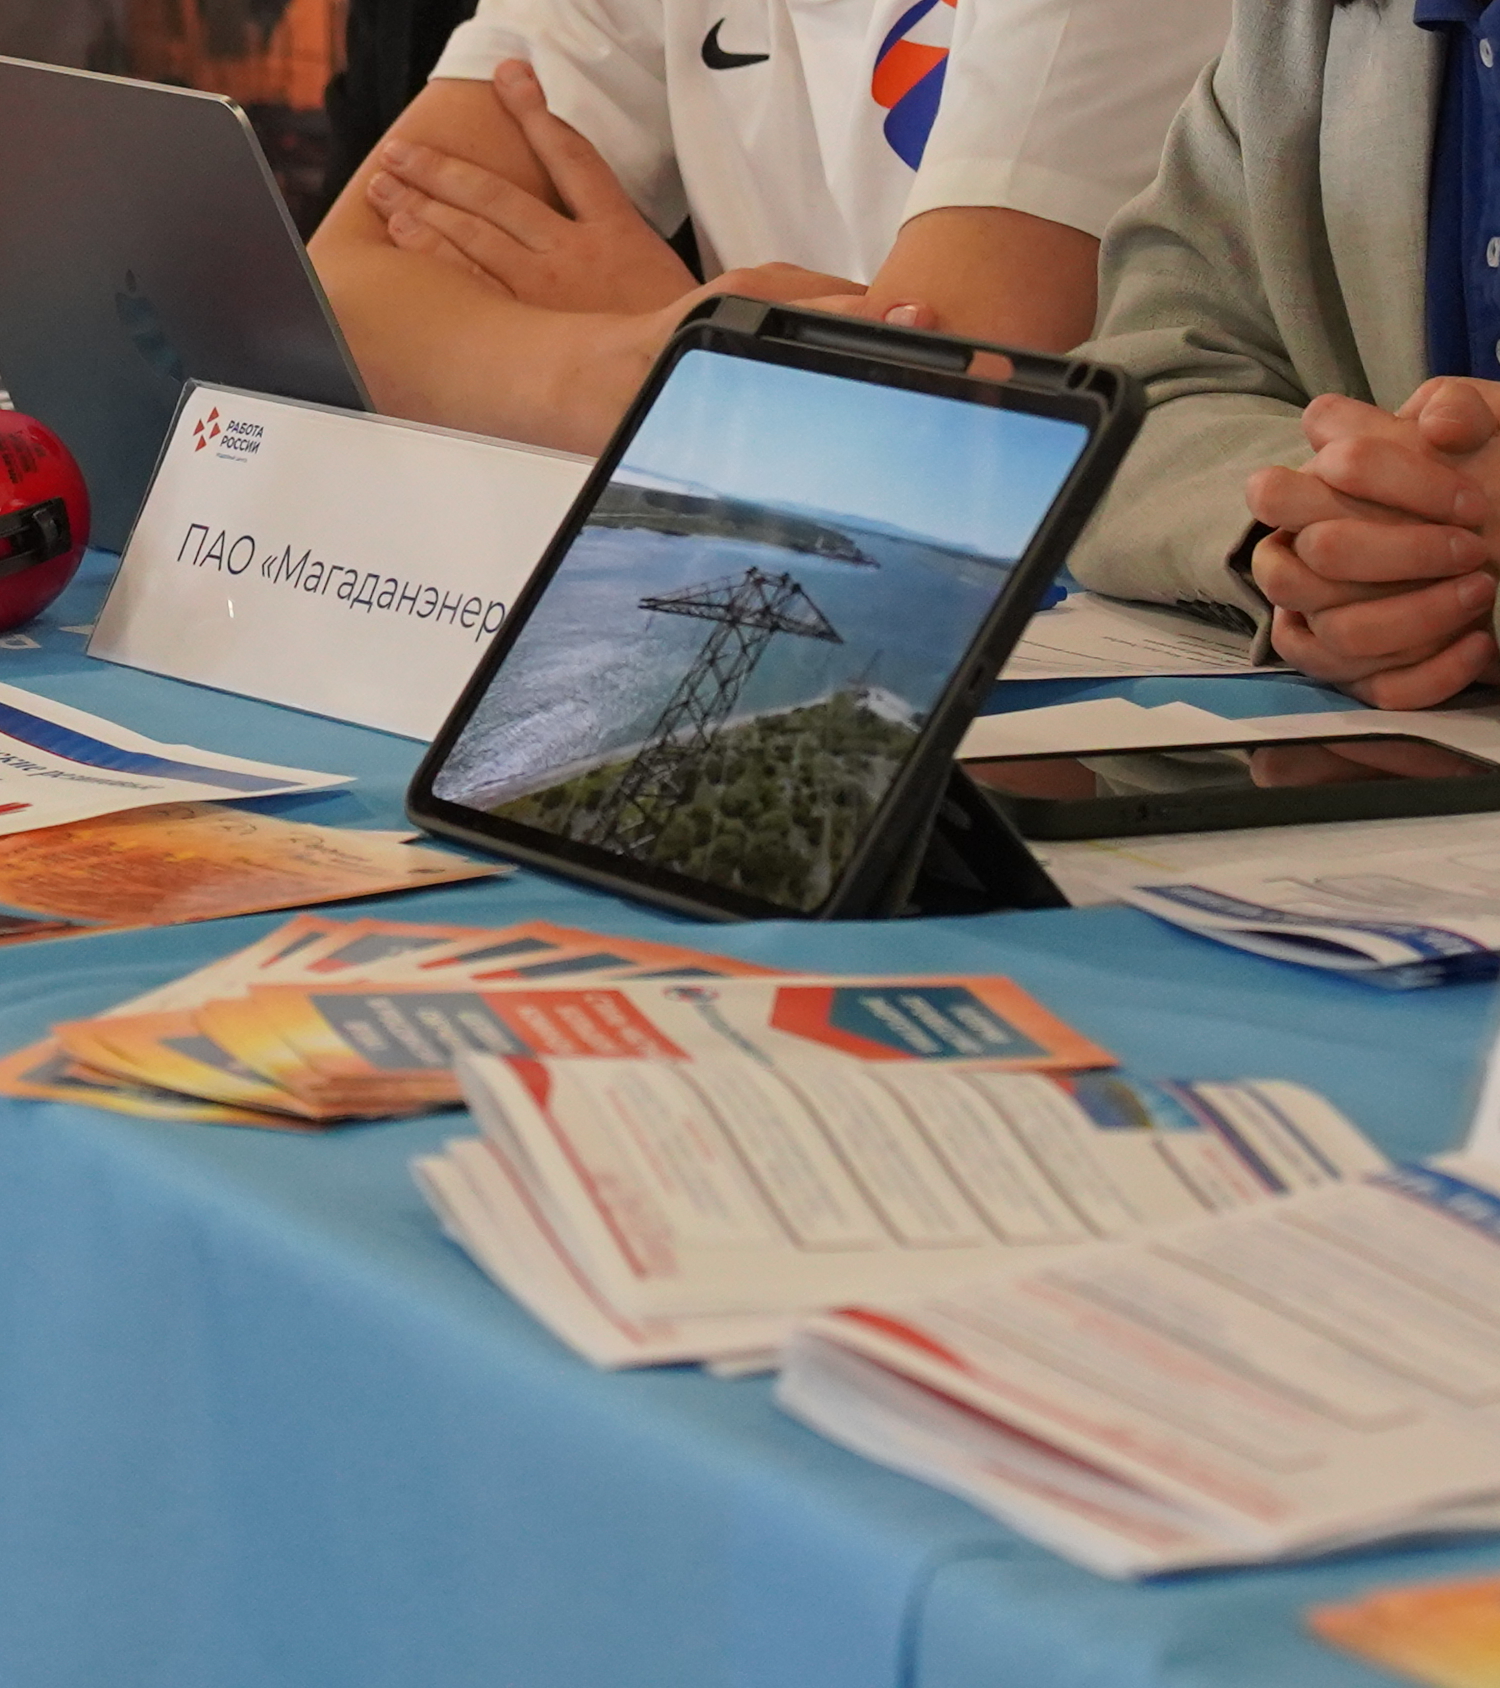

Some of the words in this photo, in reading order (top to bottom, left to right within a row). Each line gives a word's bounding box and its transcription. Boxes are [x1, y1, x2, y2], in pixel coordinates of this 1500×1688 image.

[226, 419, 264, 438] РАБОТА
[220, 435, 261, 454] РОССИИ
[177, 523, 255, 575] ПАО
[261, 544, 507, 643] «Магаданэнер
